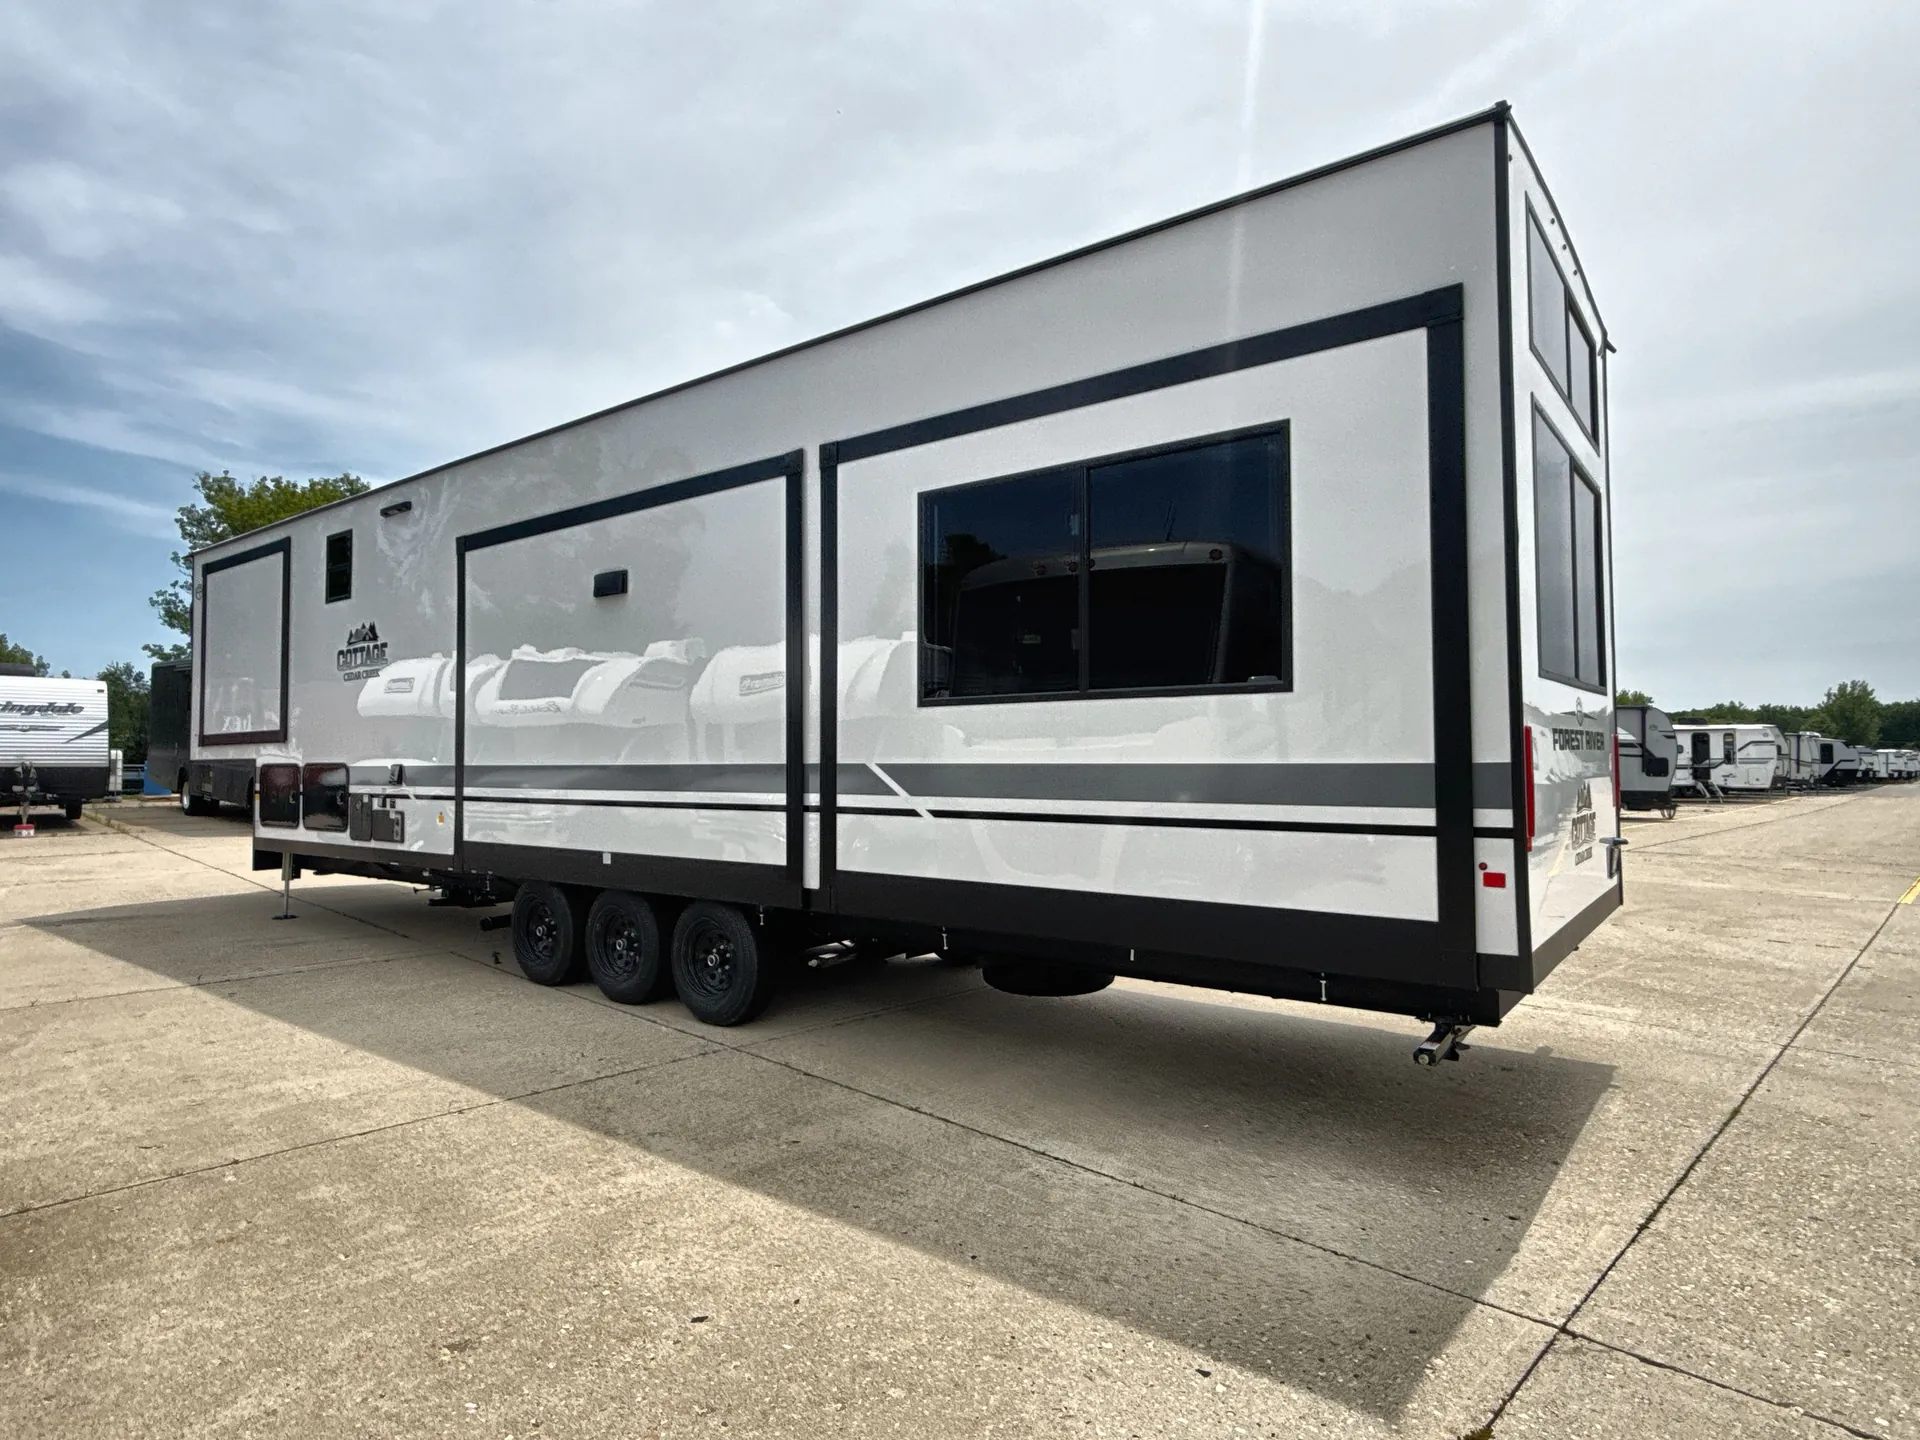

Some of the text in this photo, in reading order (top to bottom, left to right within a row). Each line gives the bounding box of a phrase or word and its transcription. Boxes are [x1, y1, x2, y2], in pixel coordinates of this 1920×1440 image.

[337, 642, 388, 671] COTTAGE
[1552, 728, 1605, 751] FOREST RIVER
